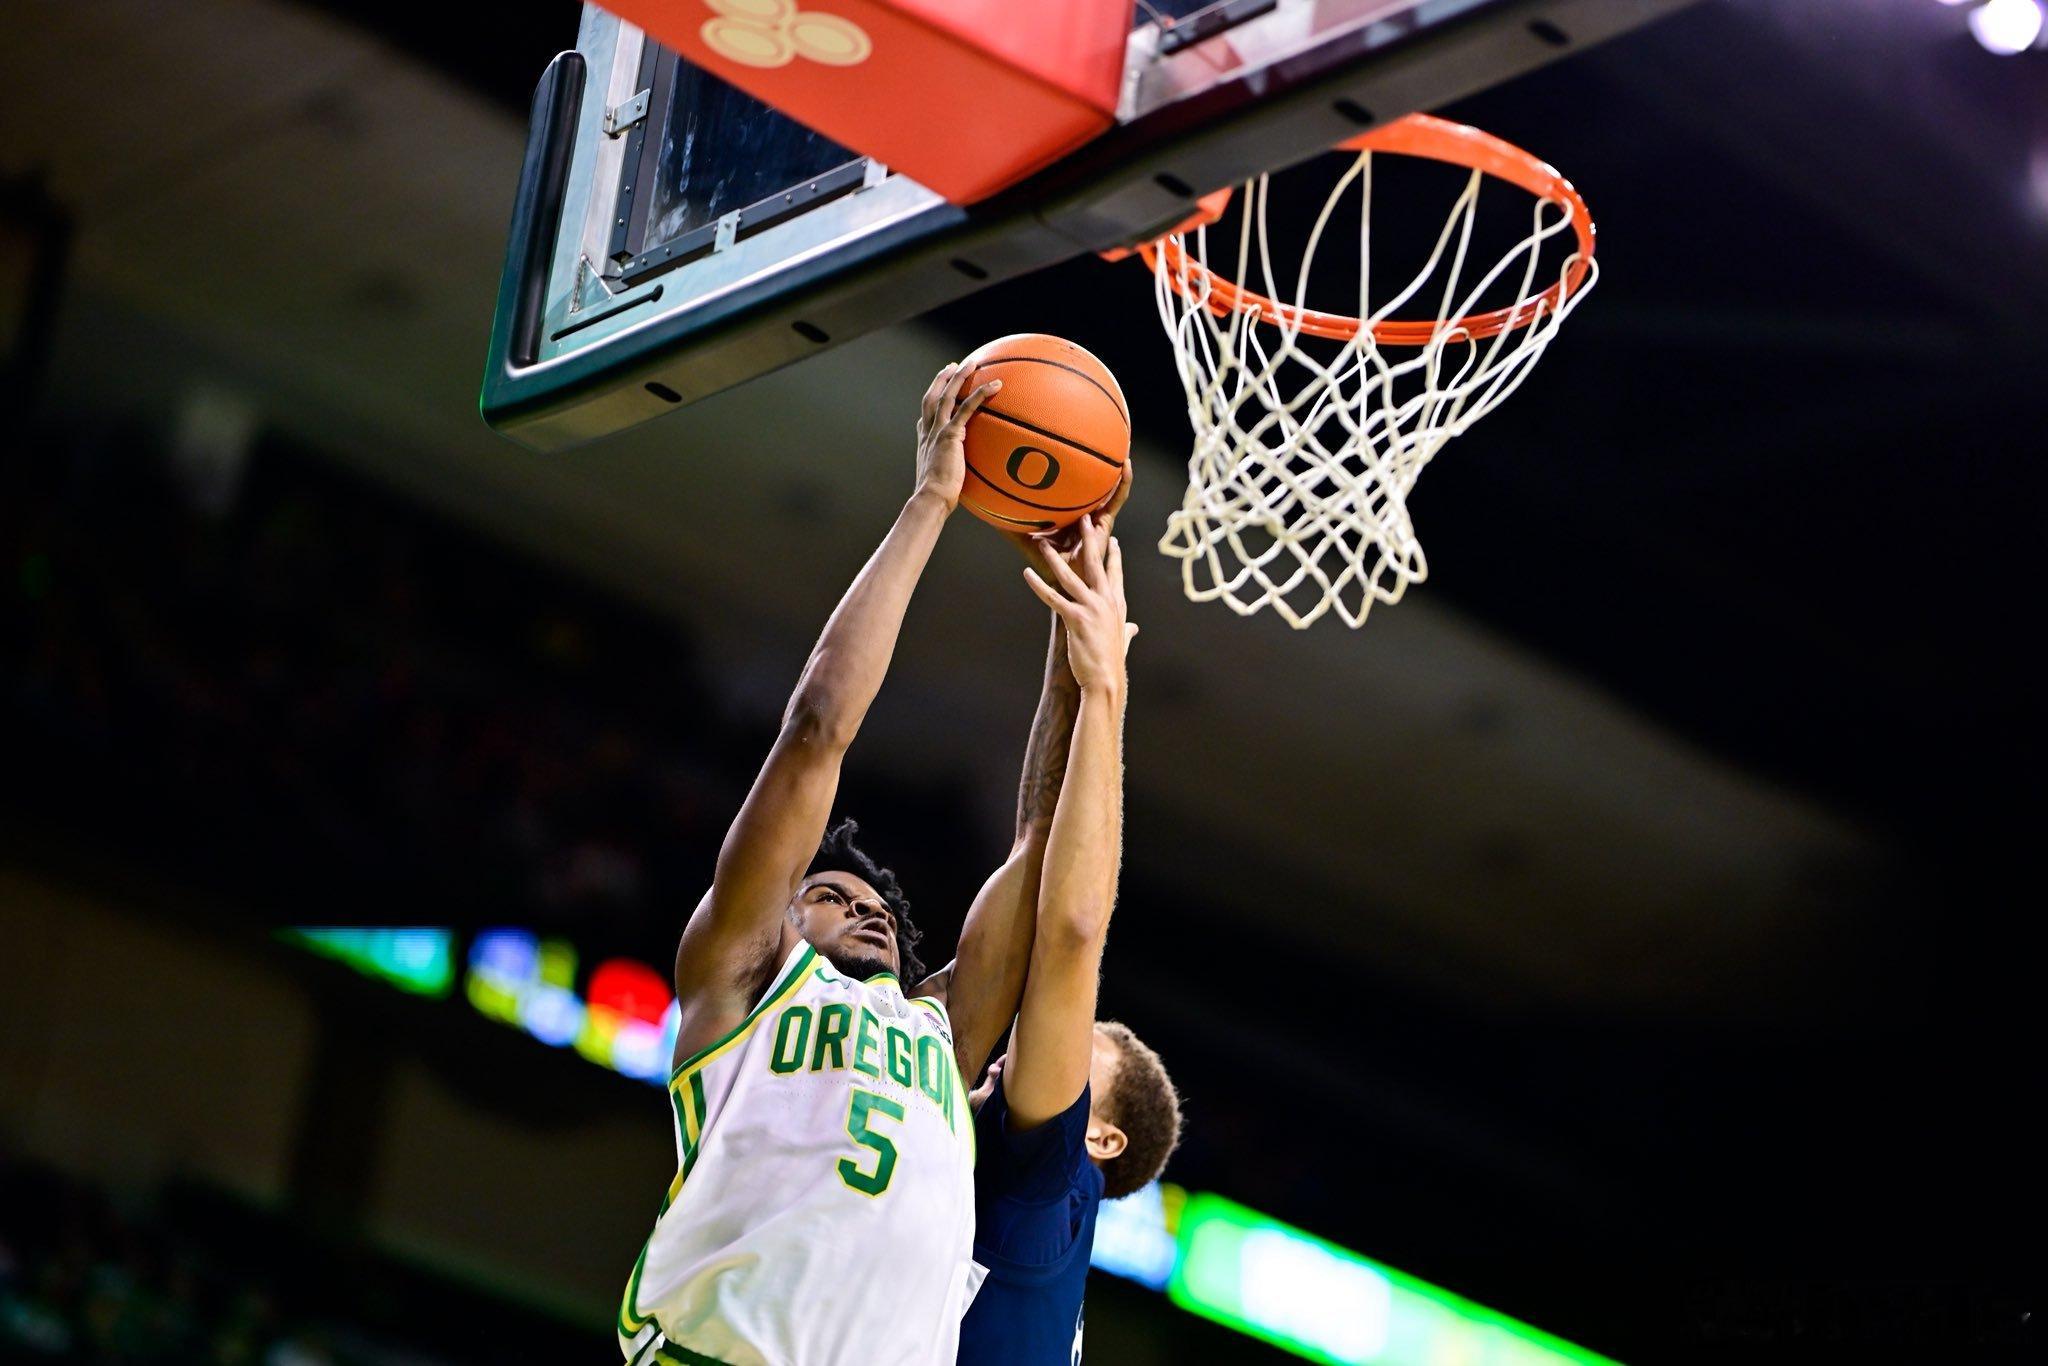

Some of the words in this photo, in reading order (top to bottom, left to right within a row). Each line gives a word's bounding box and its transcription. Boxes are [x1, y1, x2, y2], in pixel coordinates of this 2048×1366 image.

[1006, 446, 1060, 490] O
[770, 1003, 956, 1136] OREGON
[837, 1088, 905, 1197] 5
